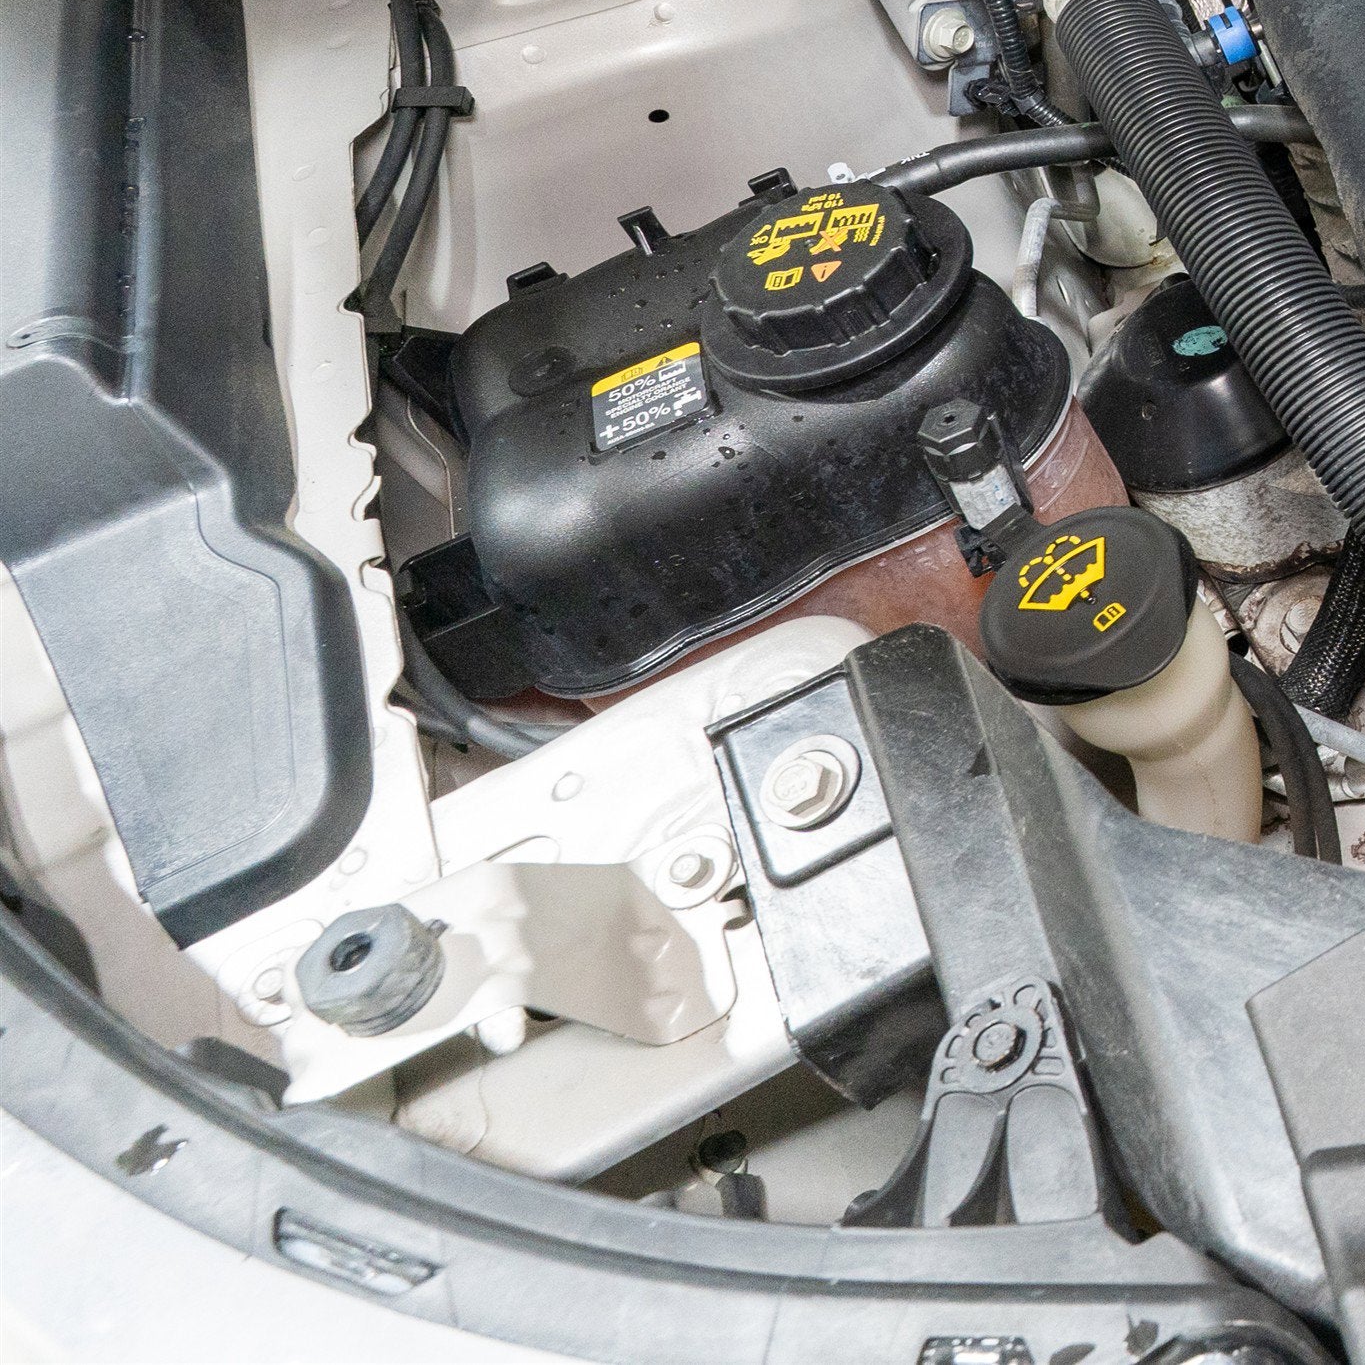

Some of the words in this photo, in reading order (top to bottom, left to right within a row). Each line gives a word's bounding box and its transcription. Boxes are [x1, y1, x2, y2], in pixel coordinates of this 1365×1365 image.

[749, 235, 769, 246] OK
[605, 392, 652, 416] SPECIALTY
[654, 377, 692, 395] ORANGE
[608, 375, 656, 402] 50%
[610, 401, 644, 419] ENGINE
[645, 383, 688, 404] COOLANT
[618, 377, 677, 405] MOTORCRAFT
[622, 403, 671, 431] 50%
